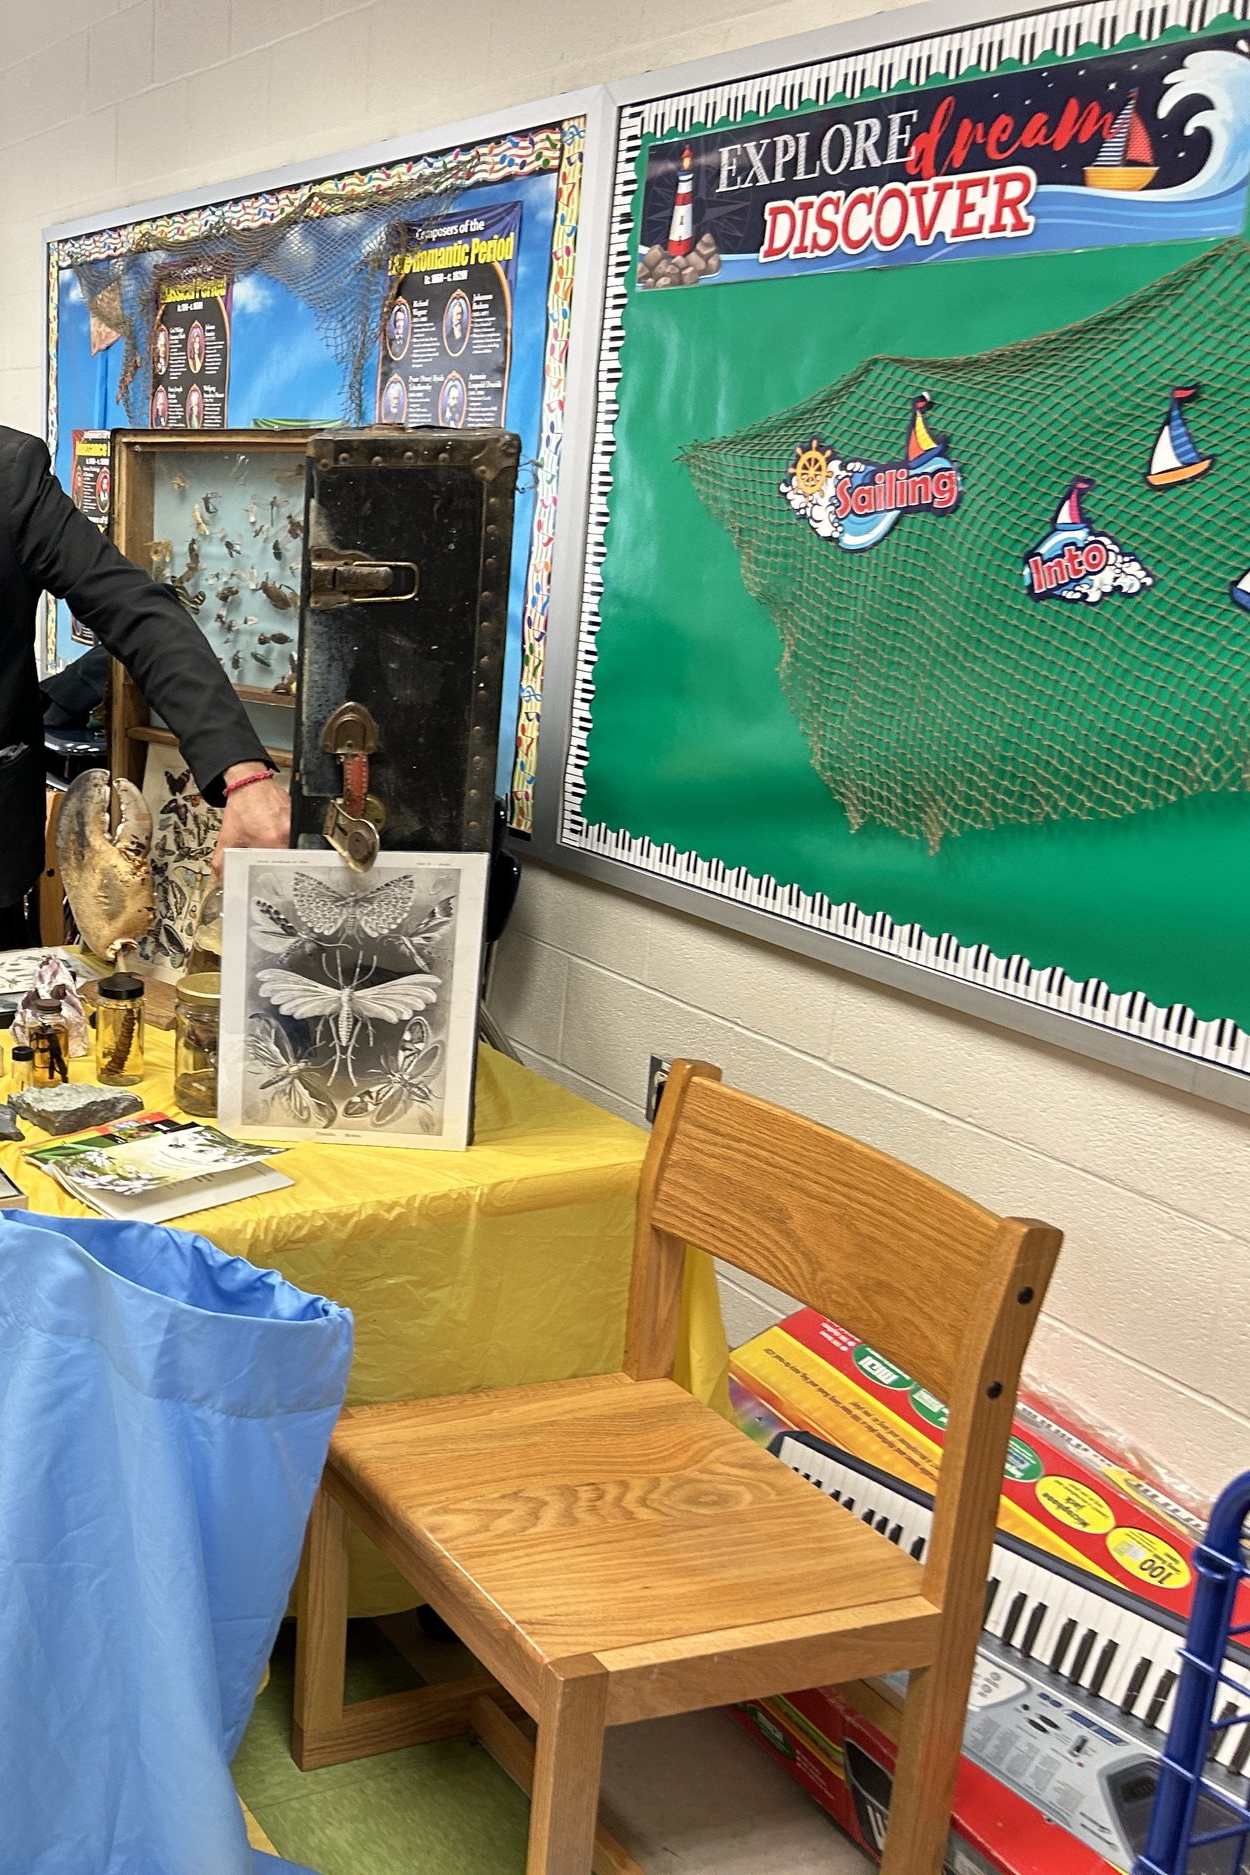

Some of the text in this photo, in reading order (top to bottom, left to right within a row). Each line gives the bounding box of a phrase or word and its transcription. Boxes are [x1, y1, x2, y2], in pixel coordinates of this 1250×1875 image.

[715, 96, 1114, 193] EXPLORE dream
[459, 220, 470, 233] of
[470, 218, 485, 231] the
[763, 170, 1033, 260] DISCOVER
[470, 232, 515, 265] Period
[835, 467, 958, 518] Sailing
[1029, 539, 1107, 592] Into
[1042, 1492, 1090, 1528] Microphone
[1065, 1497, 1085, 1509] jack
[1140, 1559, 1172, 1584] 100
